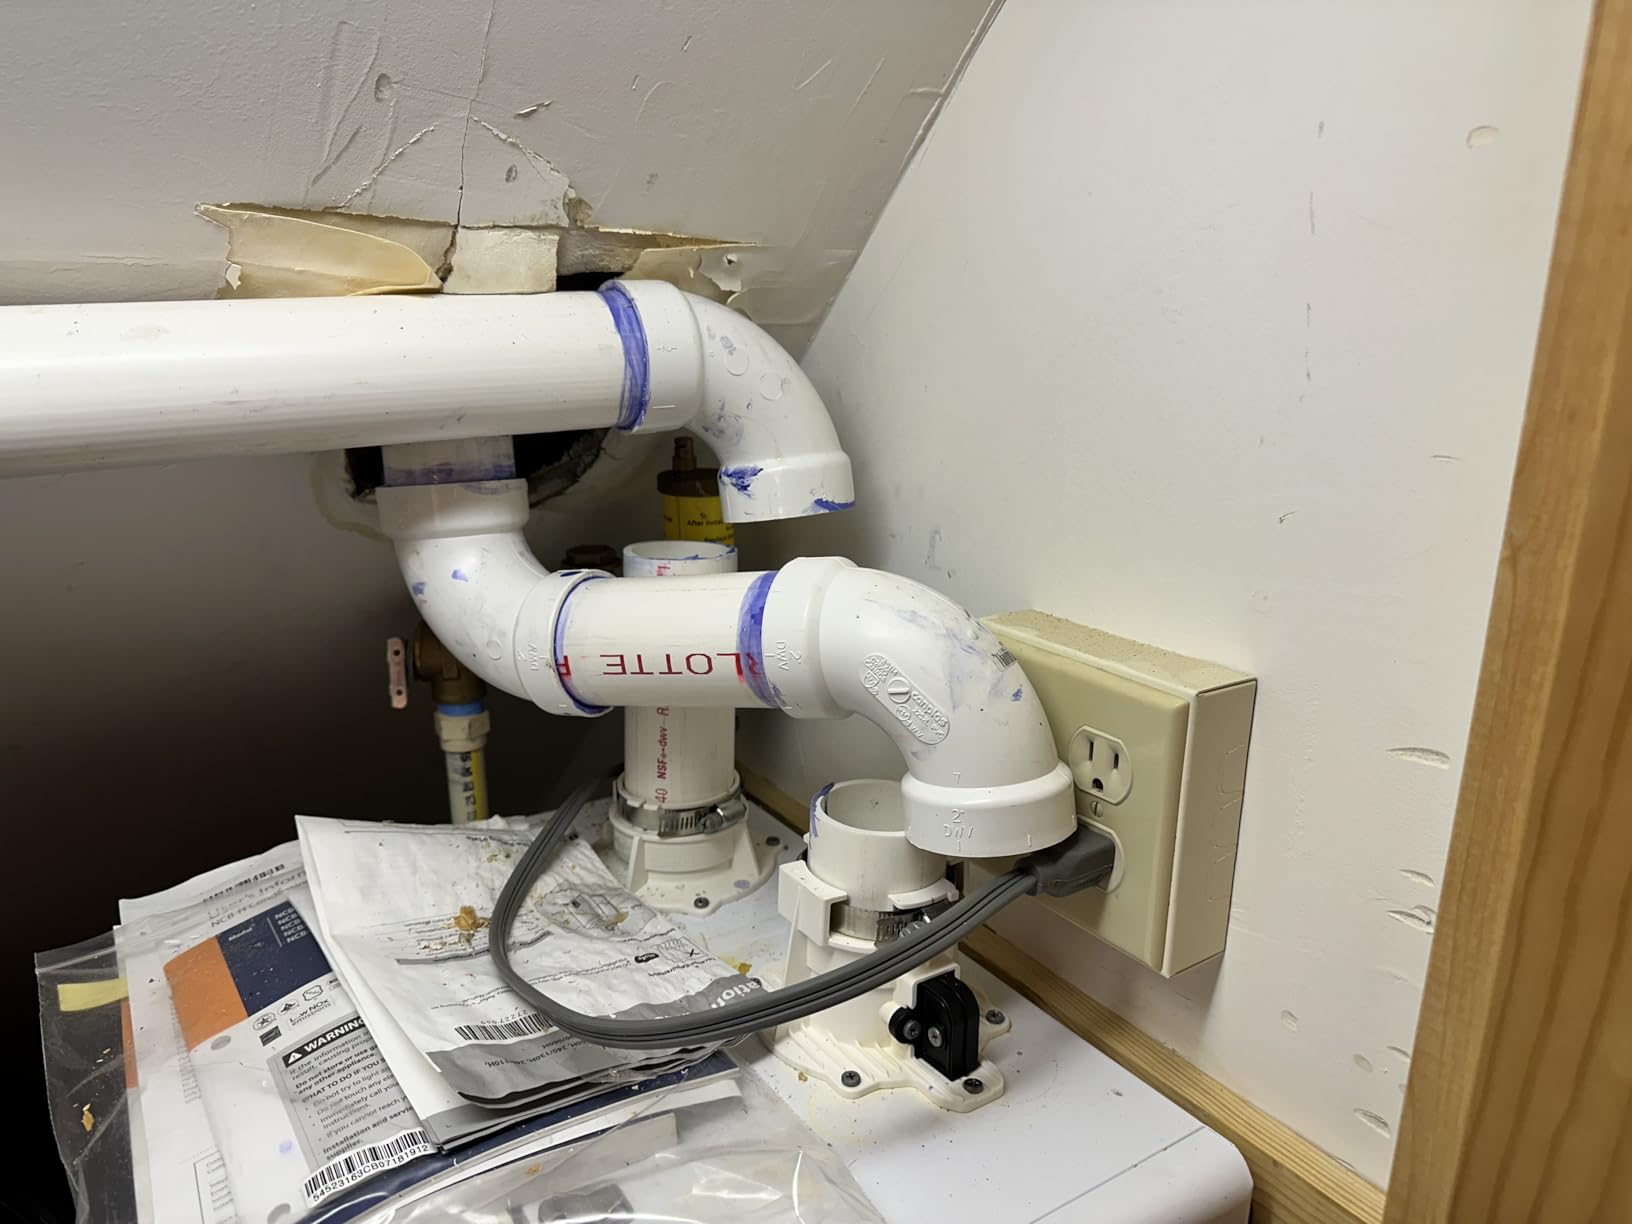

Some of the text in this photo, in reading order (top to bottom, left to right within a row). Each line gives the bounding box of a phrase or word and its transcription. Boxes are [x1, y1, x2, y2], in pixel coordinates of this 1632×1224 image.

[911, 691, 948, 727] canplas
[656, 788, 669, 804] 40
[314, 1035, 361, 1061] information
[319, 1047, 350, 1066] causing
[296, 1080, 308, 1089] Do
[308, 1071, 322, 1081] not
[323, 1060, 343, 1073] store
[354, 1048, 368, 1058] use
[326, 1080, 338, 1090] TO
[339, 1073, 353, 1083] DO
[361, 1060, 380, 1070] YOU
[299, 1084, 313, 1095] any
[313, 1072, 335, 1086] other
[326, 1090, 340, 1100] not
[341, 1084, 351, 1093] try
[361, 1070, 380, 1082] light
[344, 1086, 367, 1101] touch
[368, 1079, 382, 1090] any
[320, 1095, 369, 1124] Immediately
[369, 1088, 382, 1098] call
[350, 1109, 377, 1126] cannot
[379, 1099, 400, 1111] reach
[323, 1126, 371, 1154] Installation
[371, 1116, 388, 1129] and
